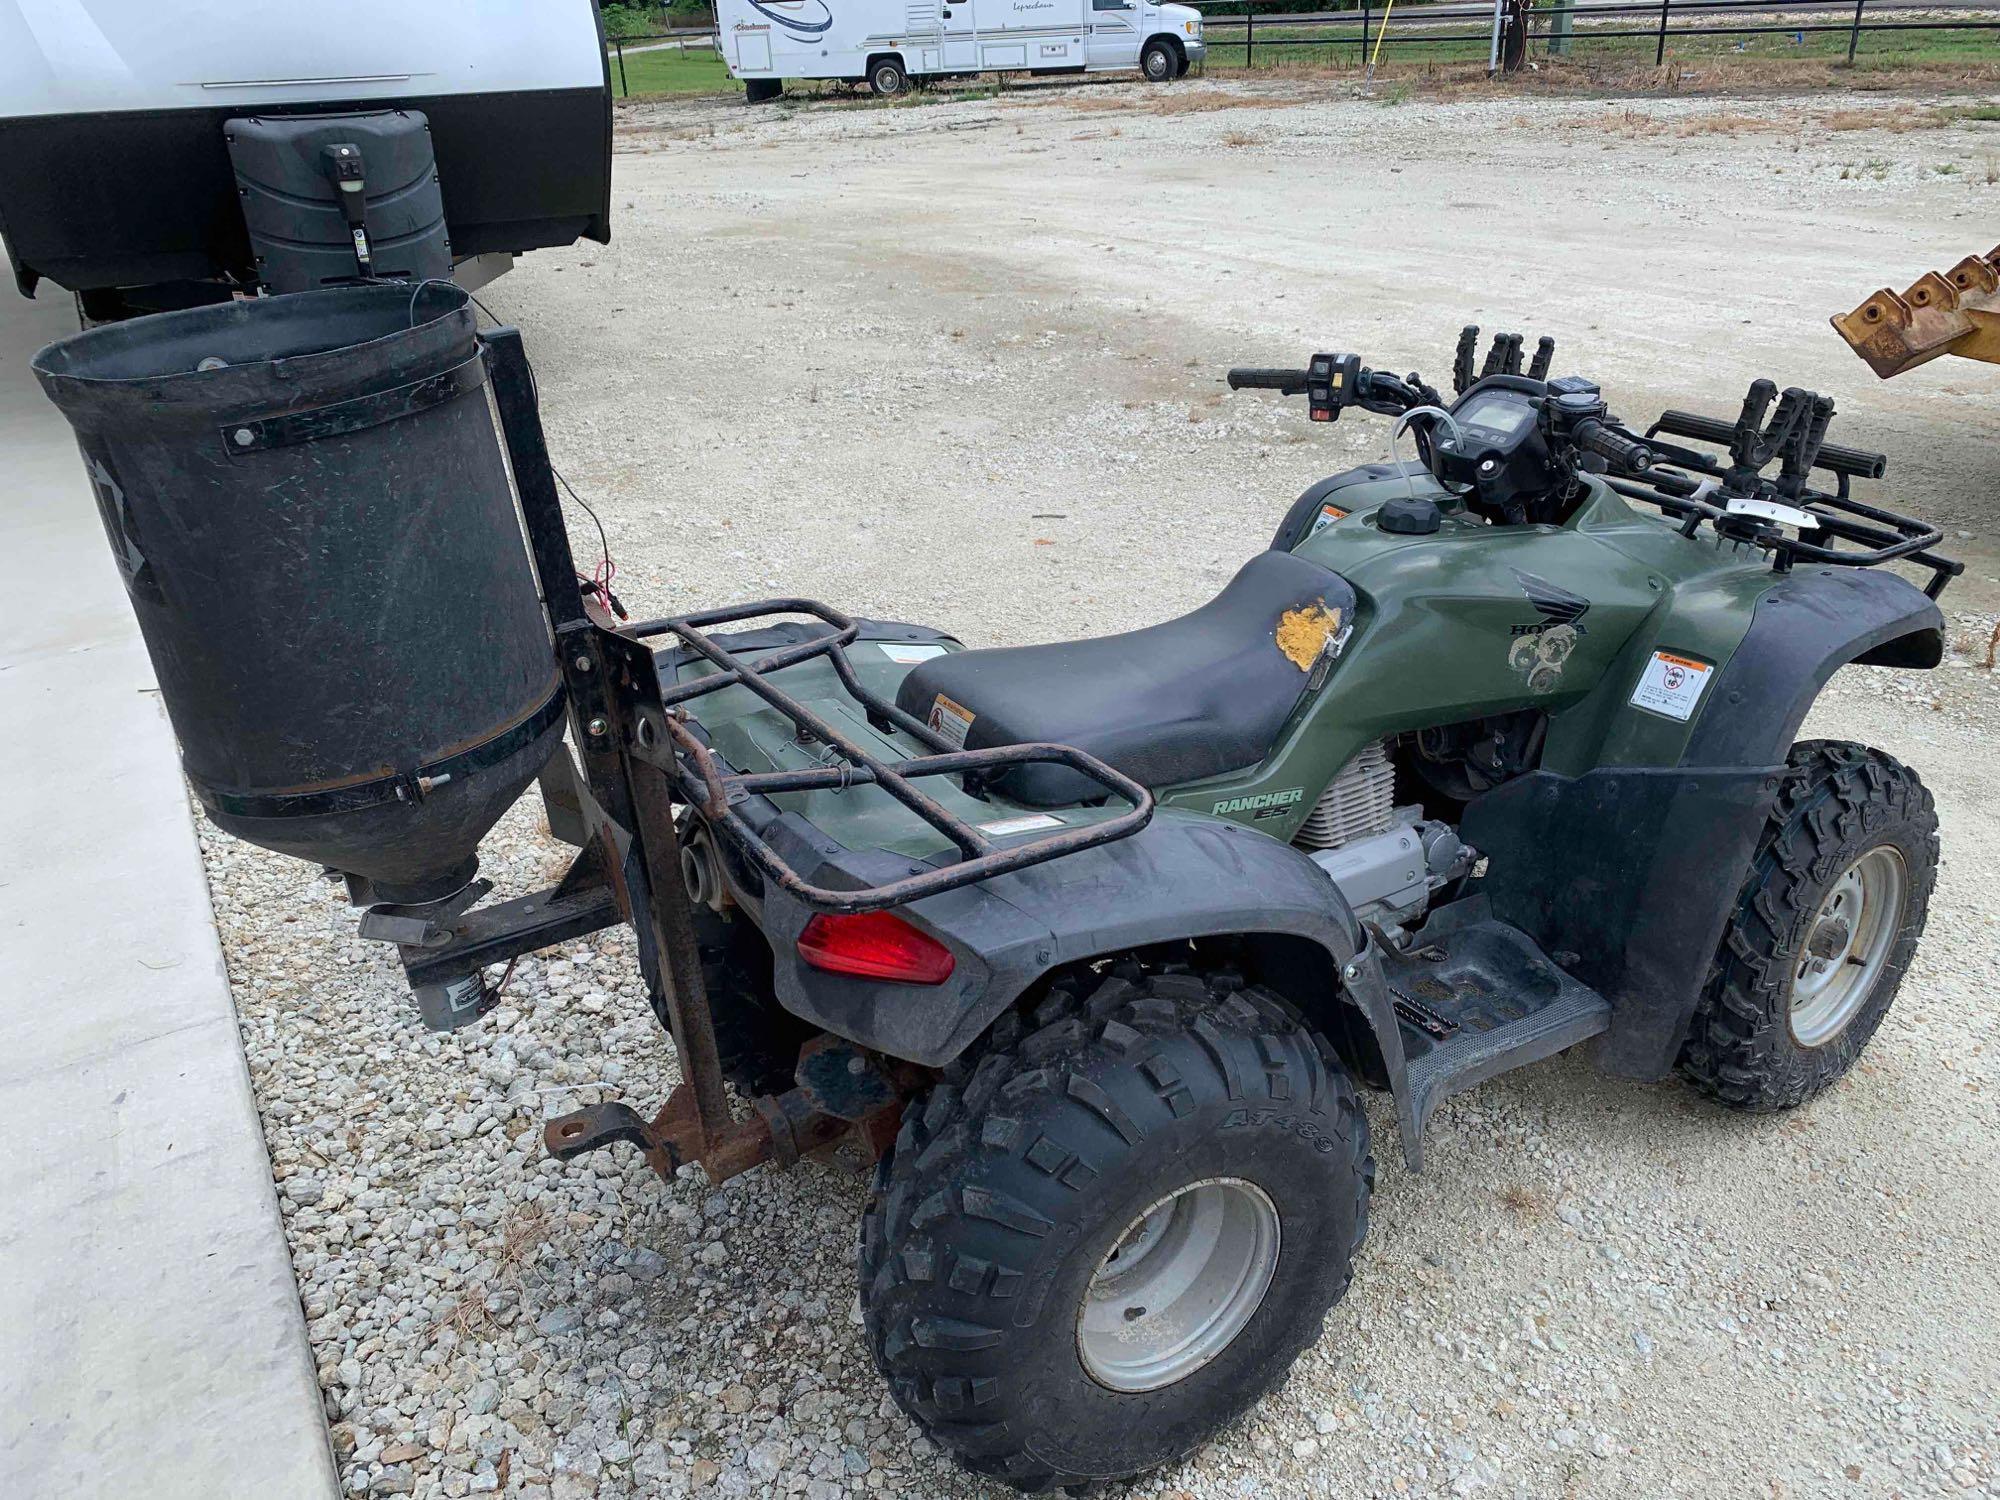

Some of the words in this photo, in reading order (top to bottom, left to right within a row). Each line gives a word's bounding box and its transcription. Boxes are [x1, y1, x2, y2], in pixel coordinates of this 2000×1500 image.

[1013, 1, 1054, 12] Leprechaun
[1510, 624, 1588, 635] HOA
[1212, 789, 1304, 815] RANCHER
[1254, 805, 1292, 821] ES
